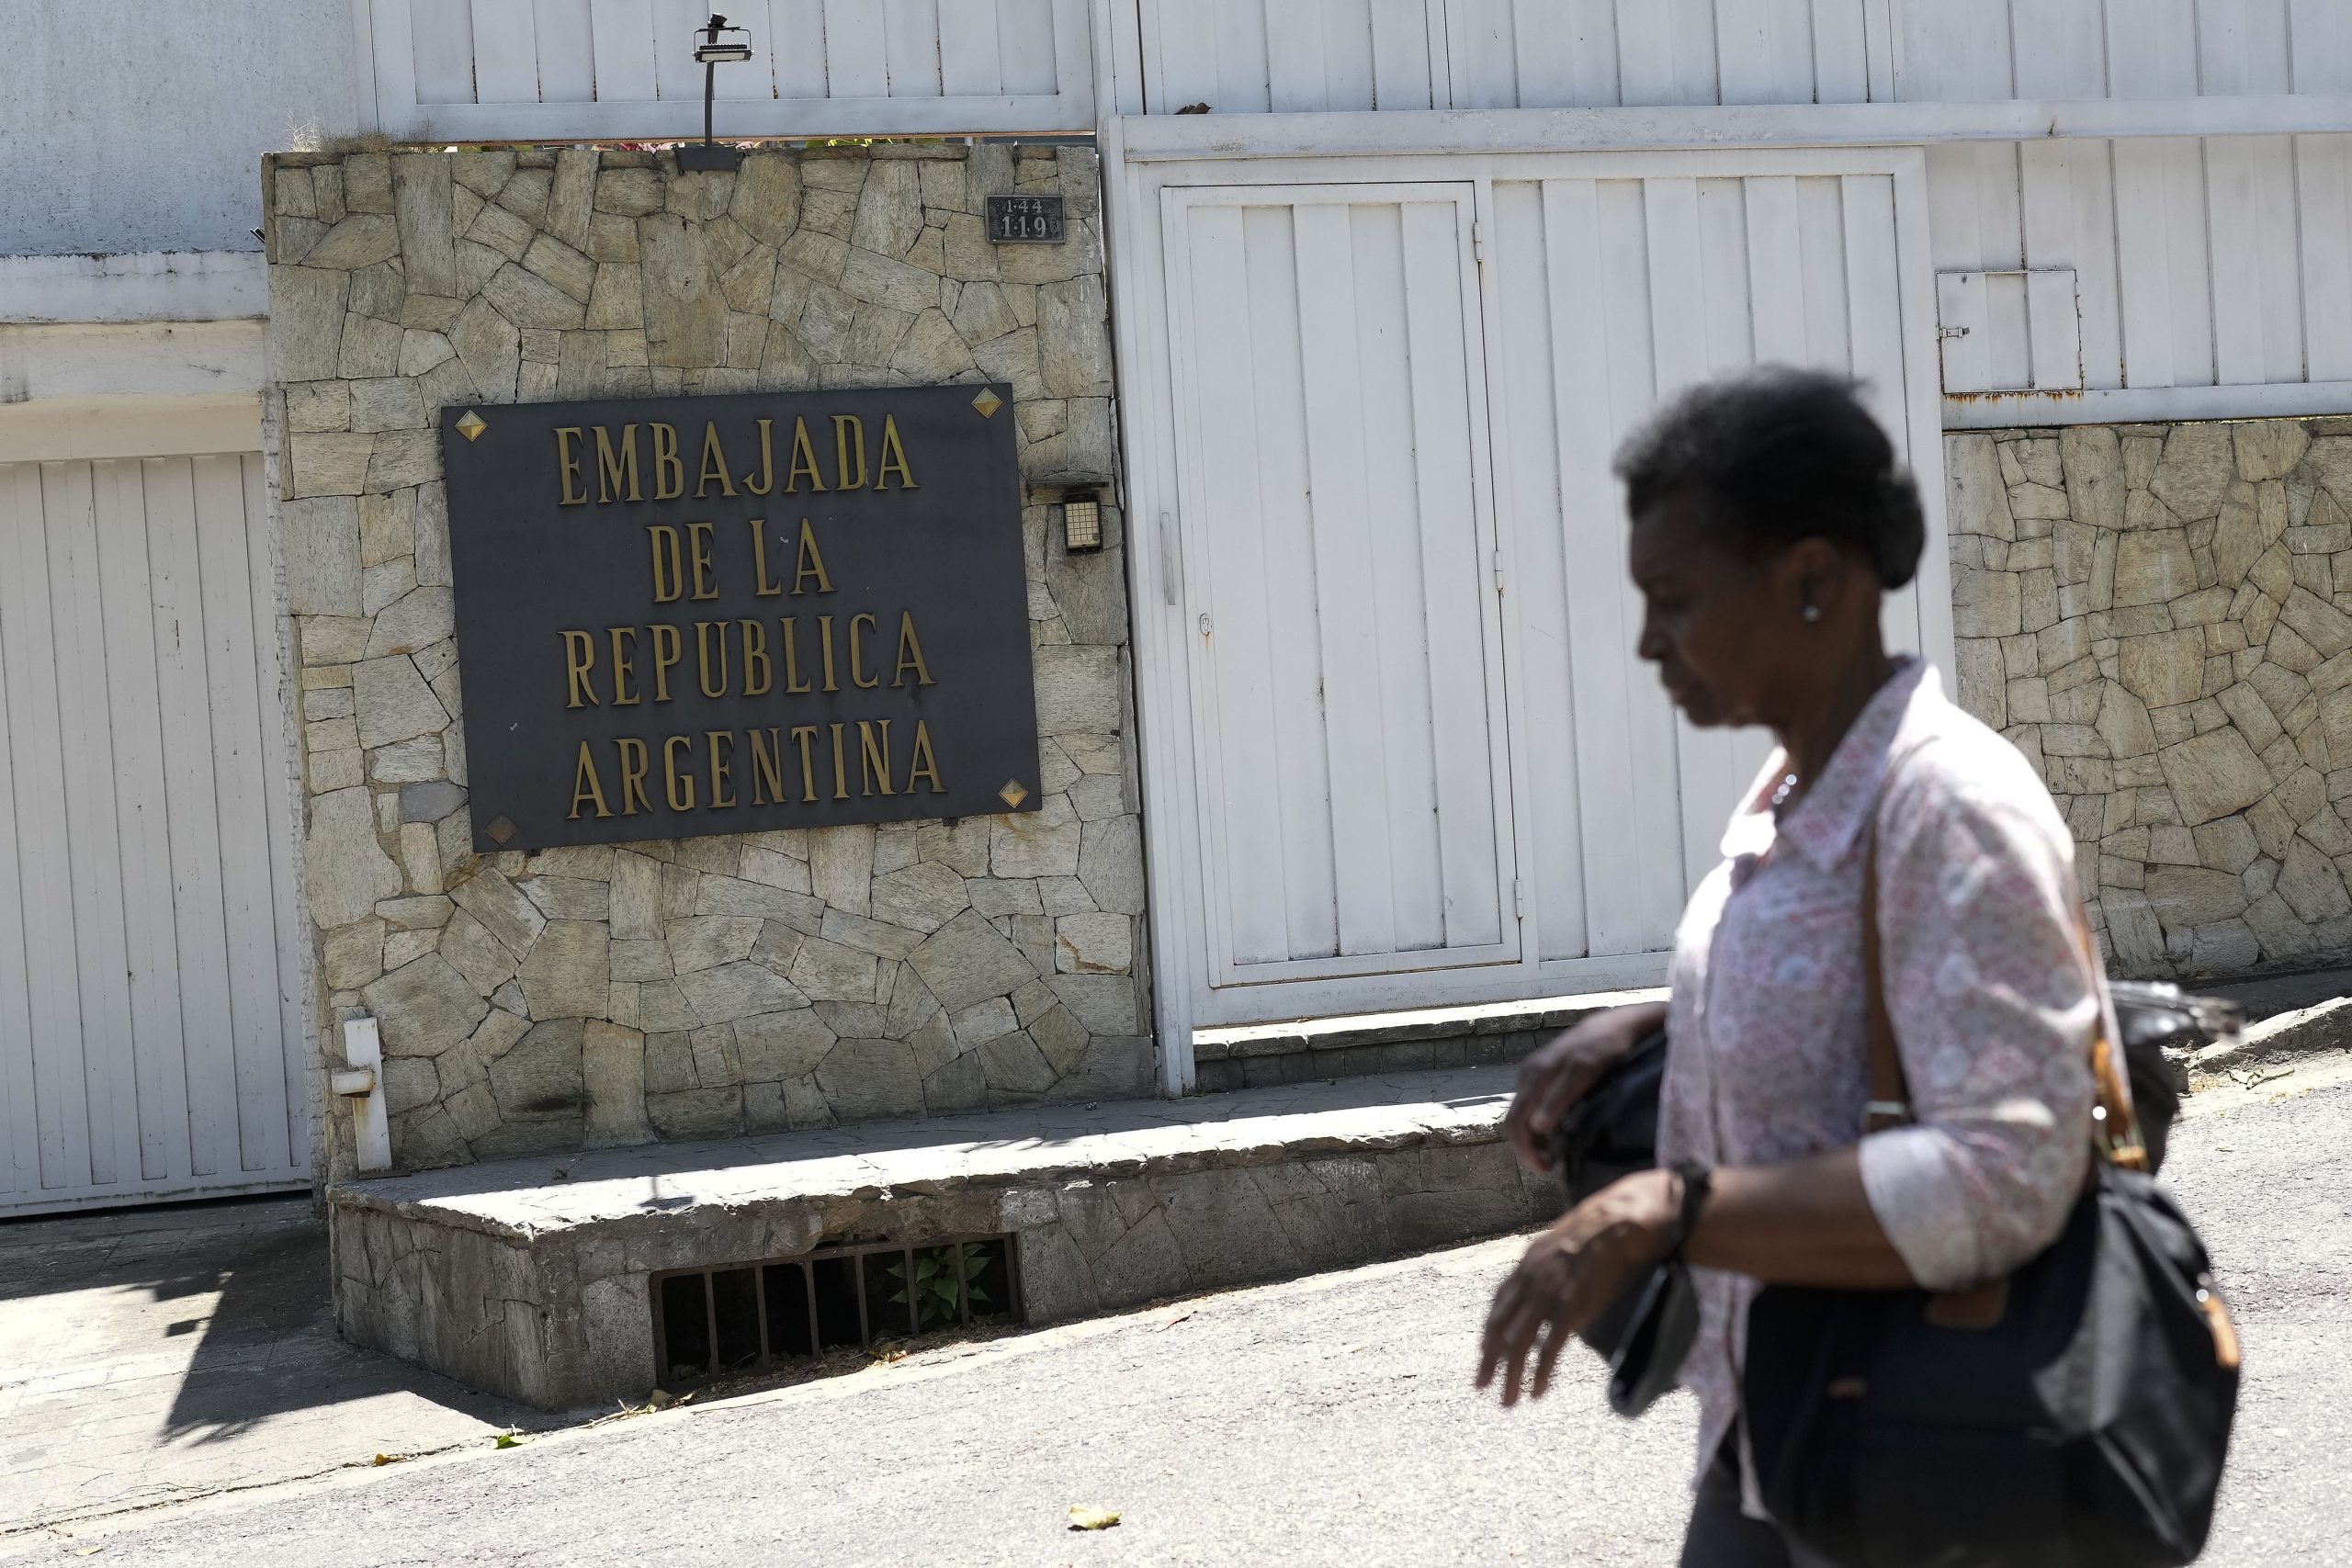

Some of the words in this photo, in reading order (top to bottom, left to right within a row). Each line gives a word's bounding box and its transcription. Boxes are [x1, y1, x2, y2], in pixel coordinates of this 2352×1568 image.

[554, 413, 922, 506] EMBAJADA
[645, 522, 718, 603] DE
[749, 516, 837, 596] LA
[557, 610, 937, 708] REPUBLICA
[566, 718, 949, 819] ARGENTINA
